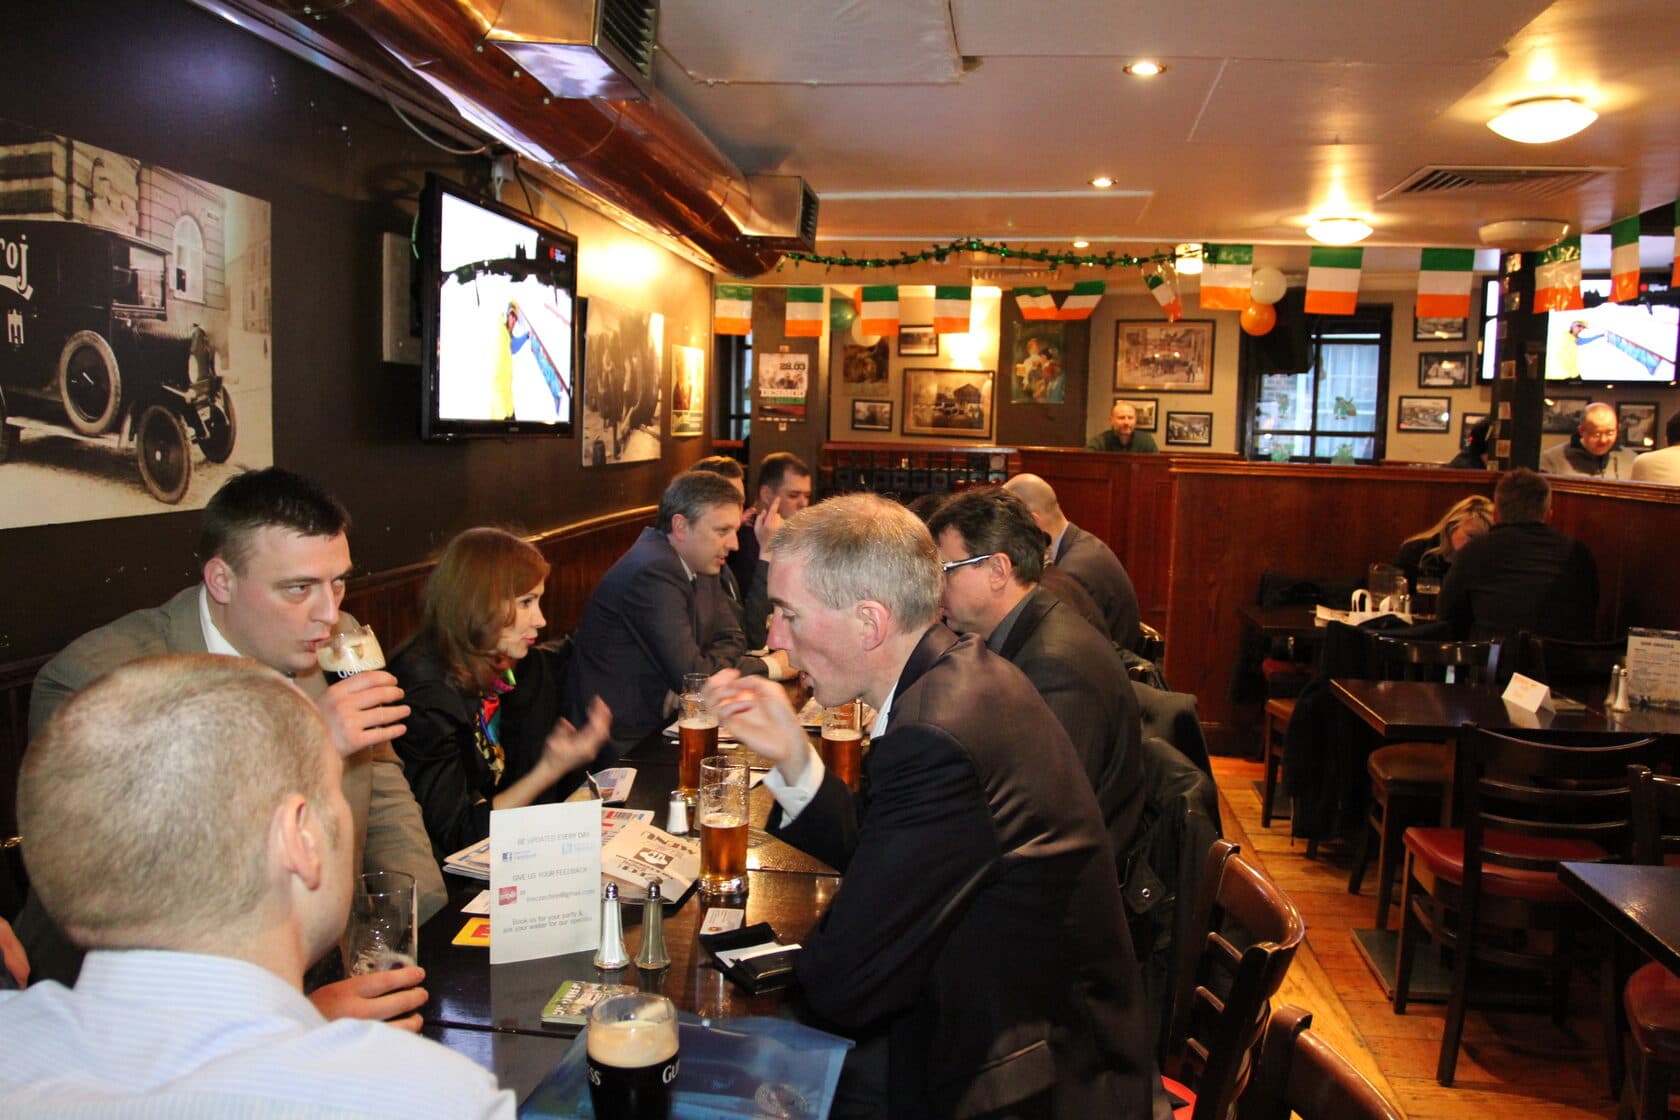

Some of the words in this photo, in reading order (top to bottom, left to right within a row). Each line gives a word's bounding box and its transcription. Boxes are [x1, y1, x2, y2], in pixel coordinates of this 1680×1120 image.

[557, 832, 577, 841] EVERY
[513, 873, 525, 882] GIVE
[527, 872, 537, 880] US
[538, 869, 556, 878] YOUR
[556, 866, 588, 876] FEEDBACK
